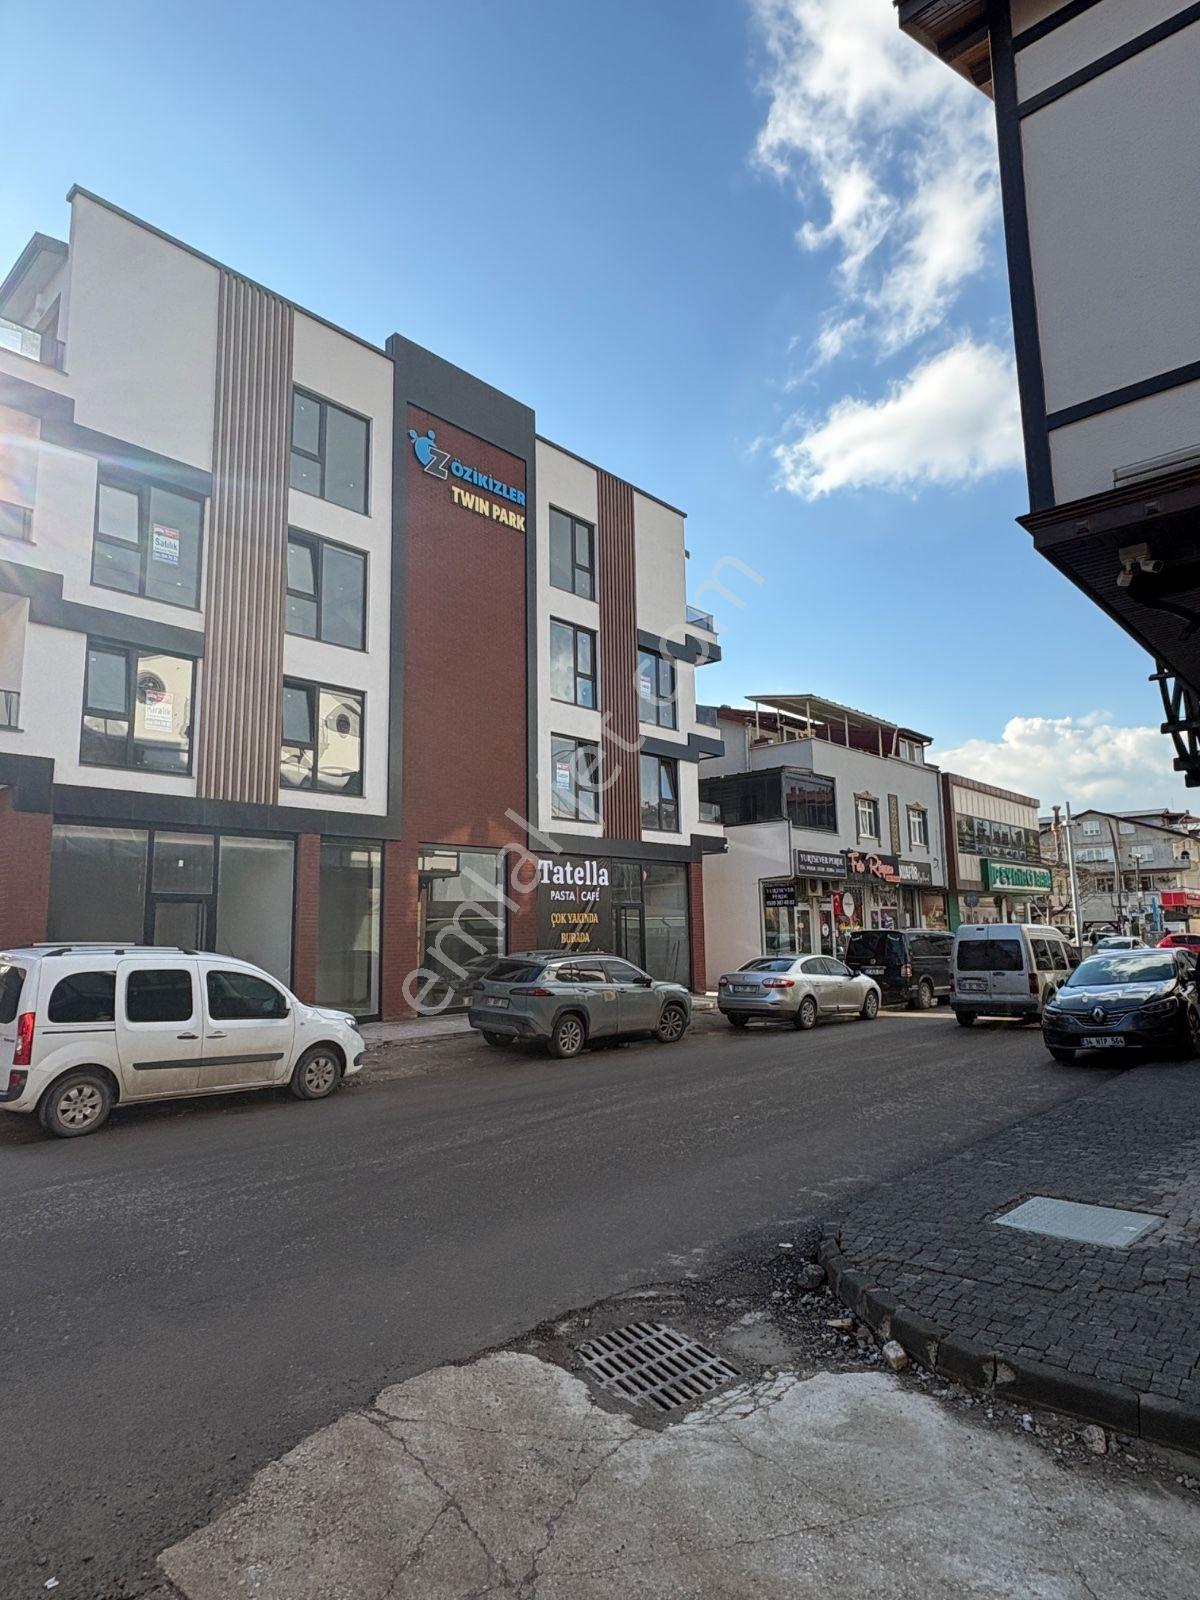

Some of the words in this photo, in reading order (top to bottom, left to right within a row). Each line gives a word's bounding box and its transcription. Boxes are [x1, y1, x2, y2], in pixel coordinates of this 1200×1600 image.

[451, 458, 526, 506] ÖZİKİZLER
[452, 486, 490, 517] TWIN
[492, 503, 526, 532] PARK
[538, 859, 609, 886] Tatella
[550, 890, 576, 901] PASTA
[581, 888, 600, 901] CAFÉ
[550, 913, 567, 927] ÇOK
[566, 913, 599, 924] YAKINDA
